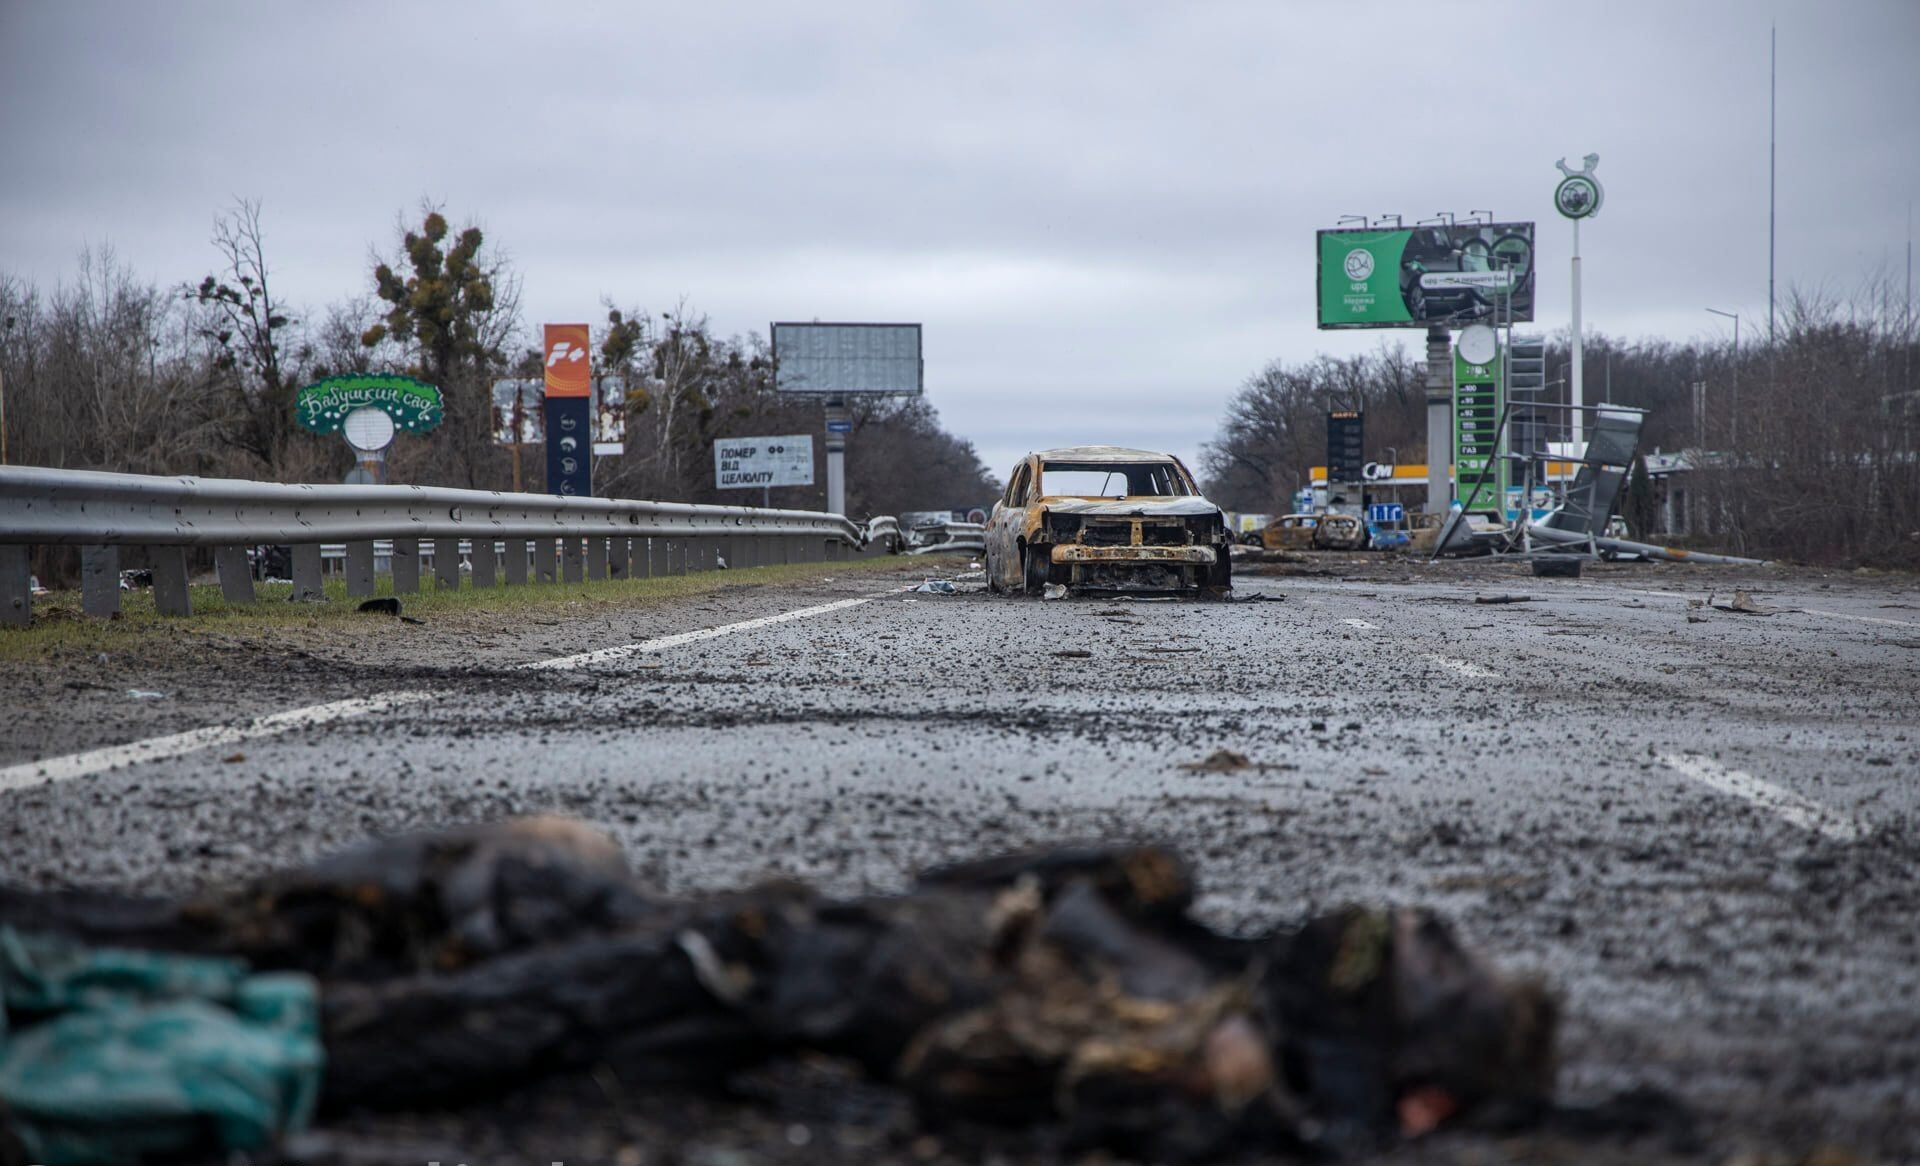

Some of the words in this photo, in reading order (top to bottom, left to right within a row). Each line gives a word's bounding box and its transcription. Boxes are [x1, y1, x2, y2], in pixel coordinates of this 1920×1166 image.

[300, 386, 400, 420] Бабушкин
[403, 390, 440, 421] сад
[720, 447, 757, 460] ПОМЕР
[1462, 446, 1477, 454] ГАЗ
[721, 460, 740, 471] ВІД
[721, 471, 774, 485] ЦЕЛЮЛІТУ
